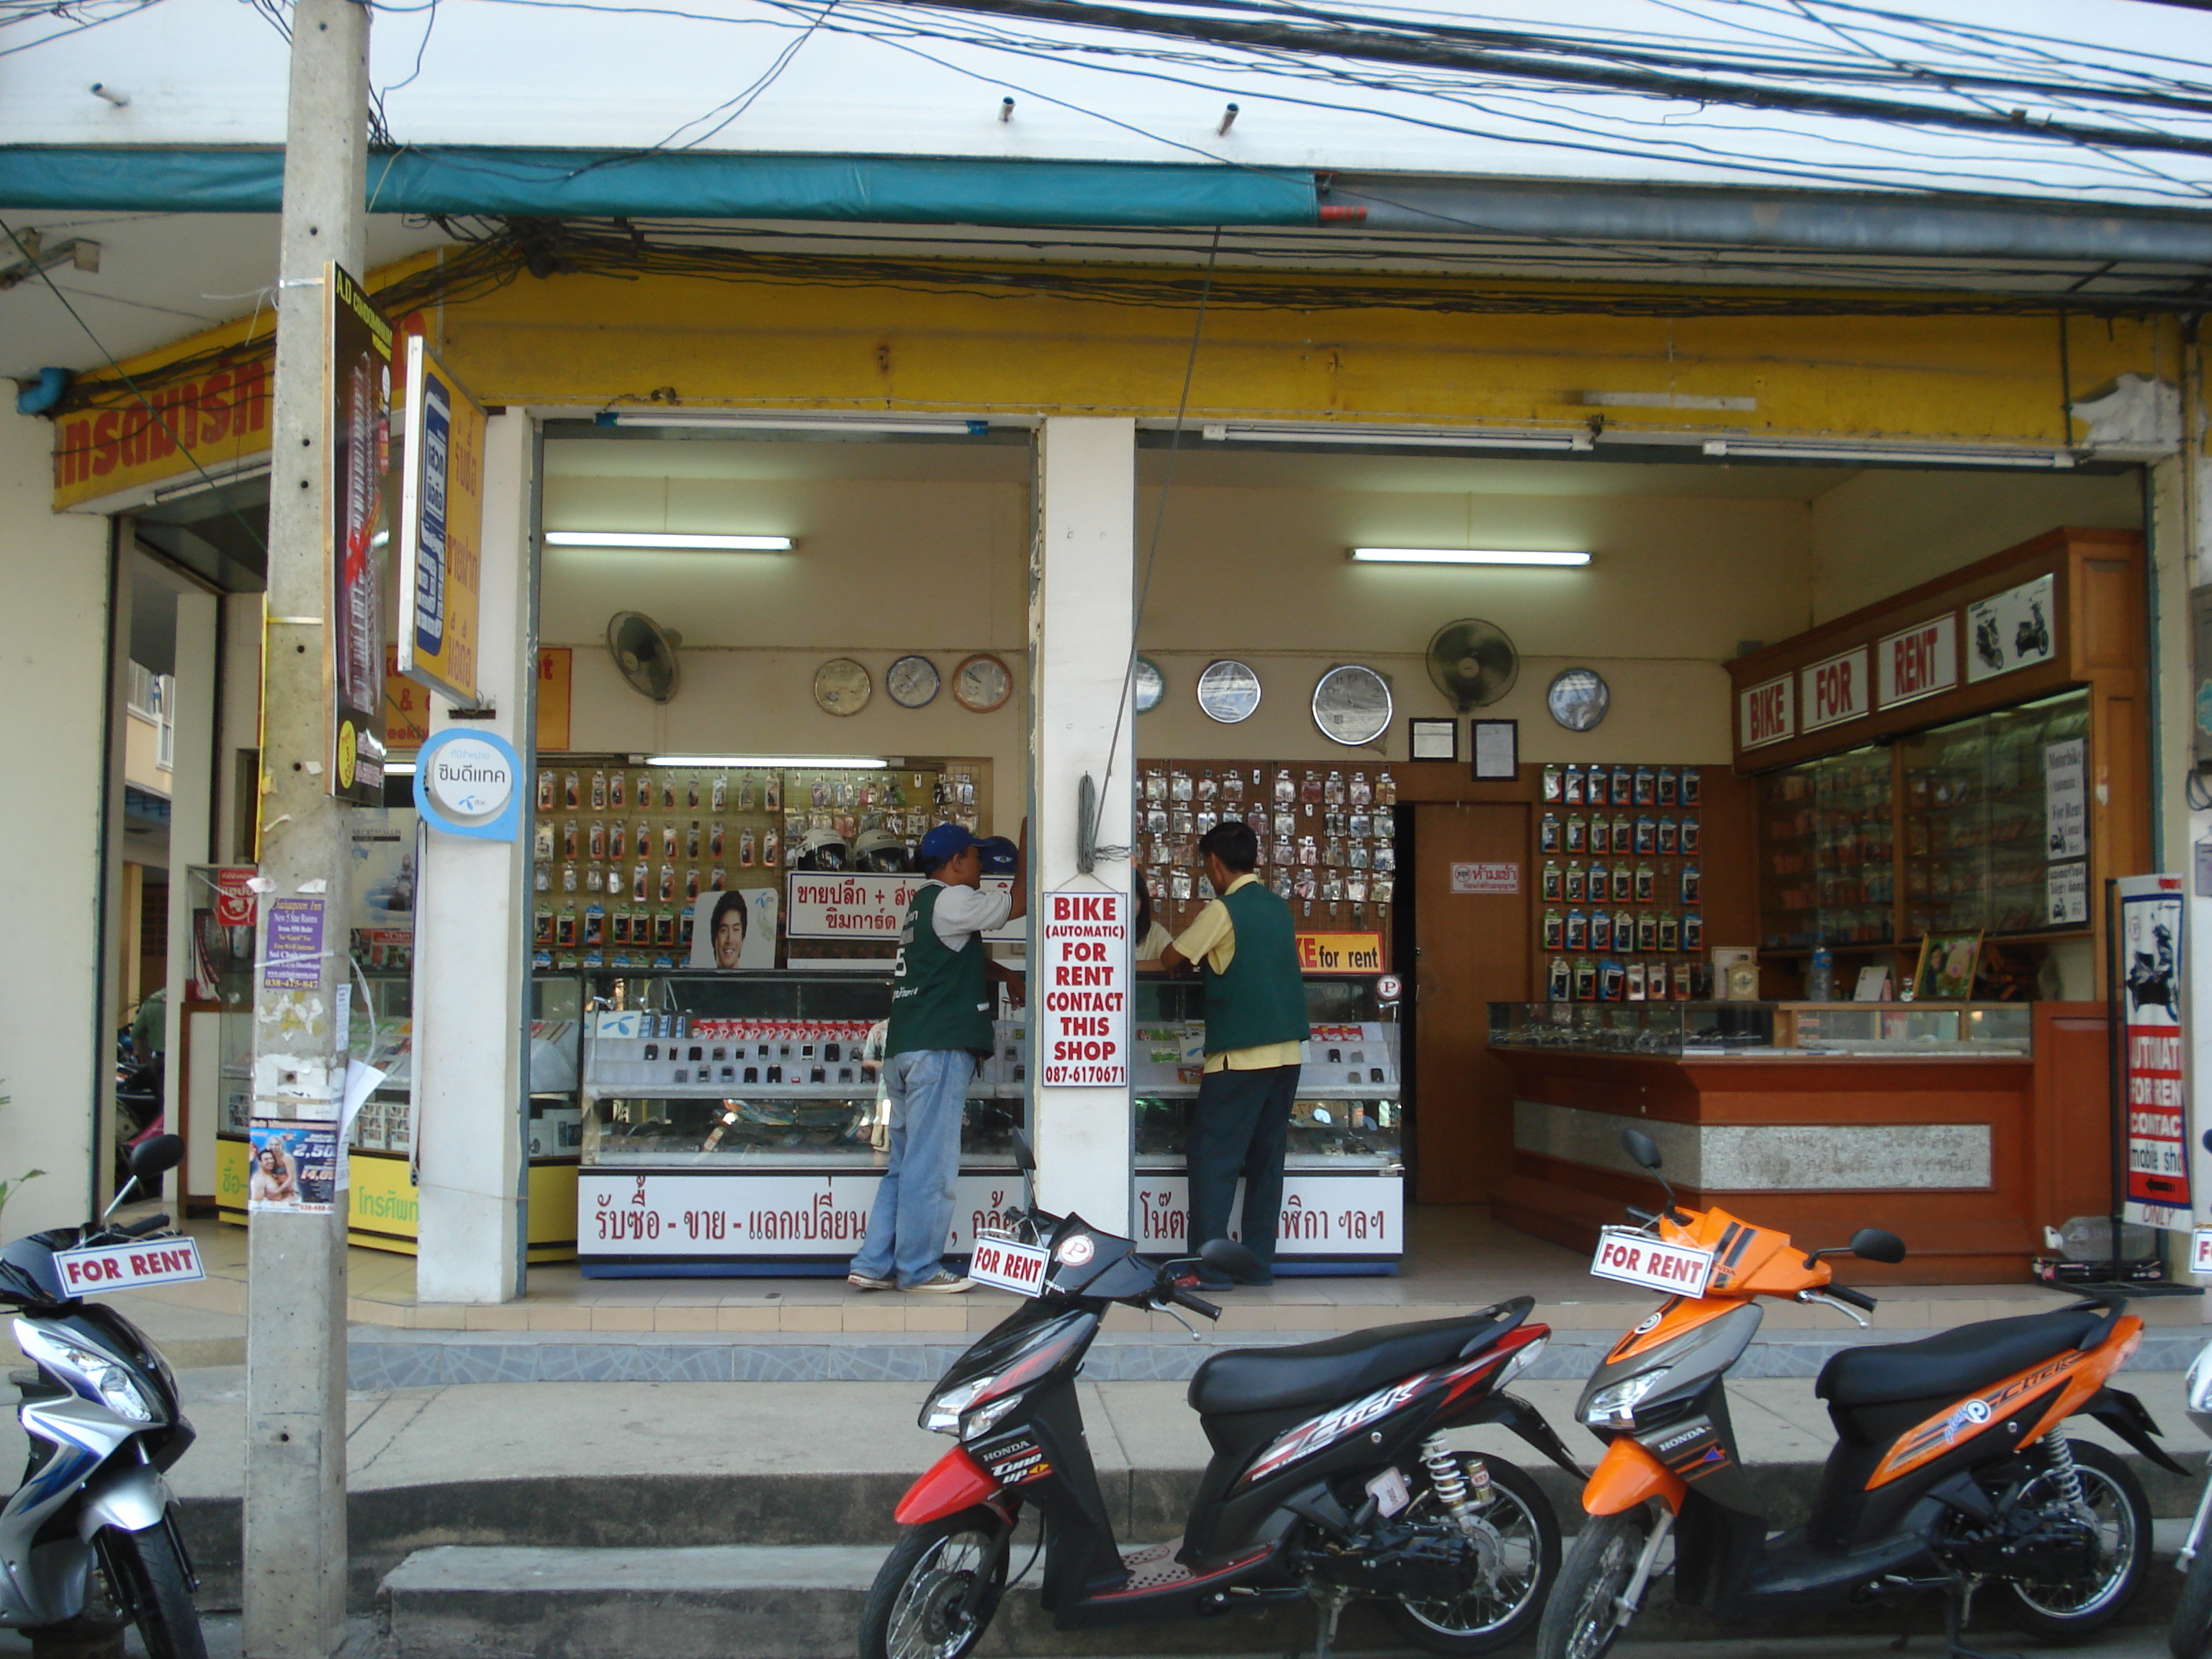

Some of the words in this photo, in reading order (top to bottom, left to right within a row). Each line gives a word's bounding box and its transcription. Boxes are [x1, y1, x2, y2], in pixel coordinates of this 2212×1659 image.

[1750, 683, 1785, 742] BIKE
[1816, 660, 1853, 720] FOR
[1894, 627, 1938, 697] RENT
[400, 688, 413, 711] &
[387, 724, 429, 742] eekly
[439, 763, 505, 783] ซิมดีแทค
[797, 878, 866, 906] ขายปลีก
[1054, 897, 1116, 921] BIKE
[1046, 925, 1125, 940] (AUTOMATIC)
[1063, 942, 1107, 961] FOR
[1296, 938, 1318, 968] KE
[1319, 945, 1339, 968] for
[1349, 945, 1378, 968] rent
[1056, 966, 1114, 986] RENT
[1046, 992, 1123, 1012] CONTACT
[1060, 1017, 1110, 1036] THIS
[1054, 1041, 1115, 1061] SHOP
[1046, 1066, 1125, 1082] 087-6170671
[2153, 1080, 2182, 1107] REN
[2132, 1112, 2182, 1138] CONTAC
[595, 1175, 660, 1240] รับซื้อ
[683, 1210, 726, 1240] ขาย
[749, 1175, 867, 1240] แลกเปลี่ยน
[1140, 1190, 1190, 1239] โน๊ต
[2141, 1203, 2176, 1225] ONLY
[2199, 1240, 2212, 1262] F
[66, 1258, 124, 1284] FOR
[128, 1249, 193, 1277] RENT
[974, 1246, 1001, 1274] FOR
[1003, 1253, 1043, 1284] RENT
[1601, 1243, 1641, 1272] FOR
[1646, 1251, 1704, 1285] RENT
[982, 1439, 1030, 1462] HONDA
[1658, 1426, 1707, 1452] HONDA
